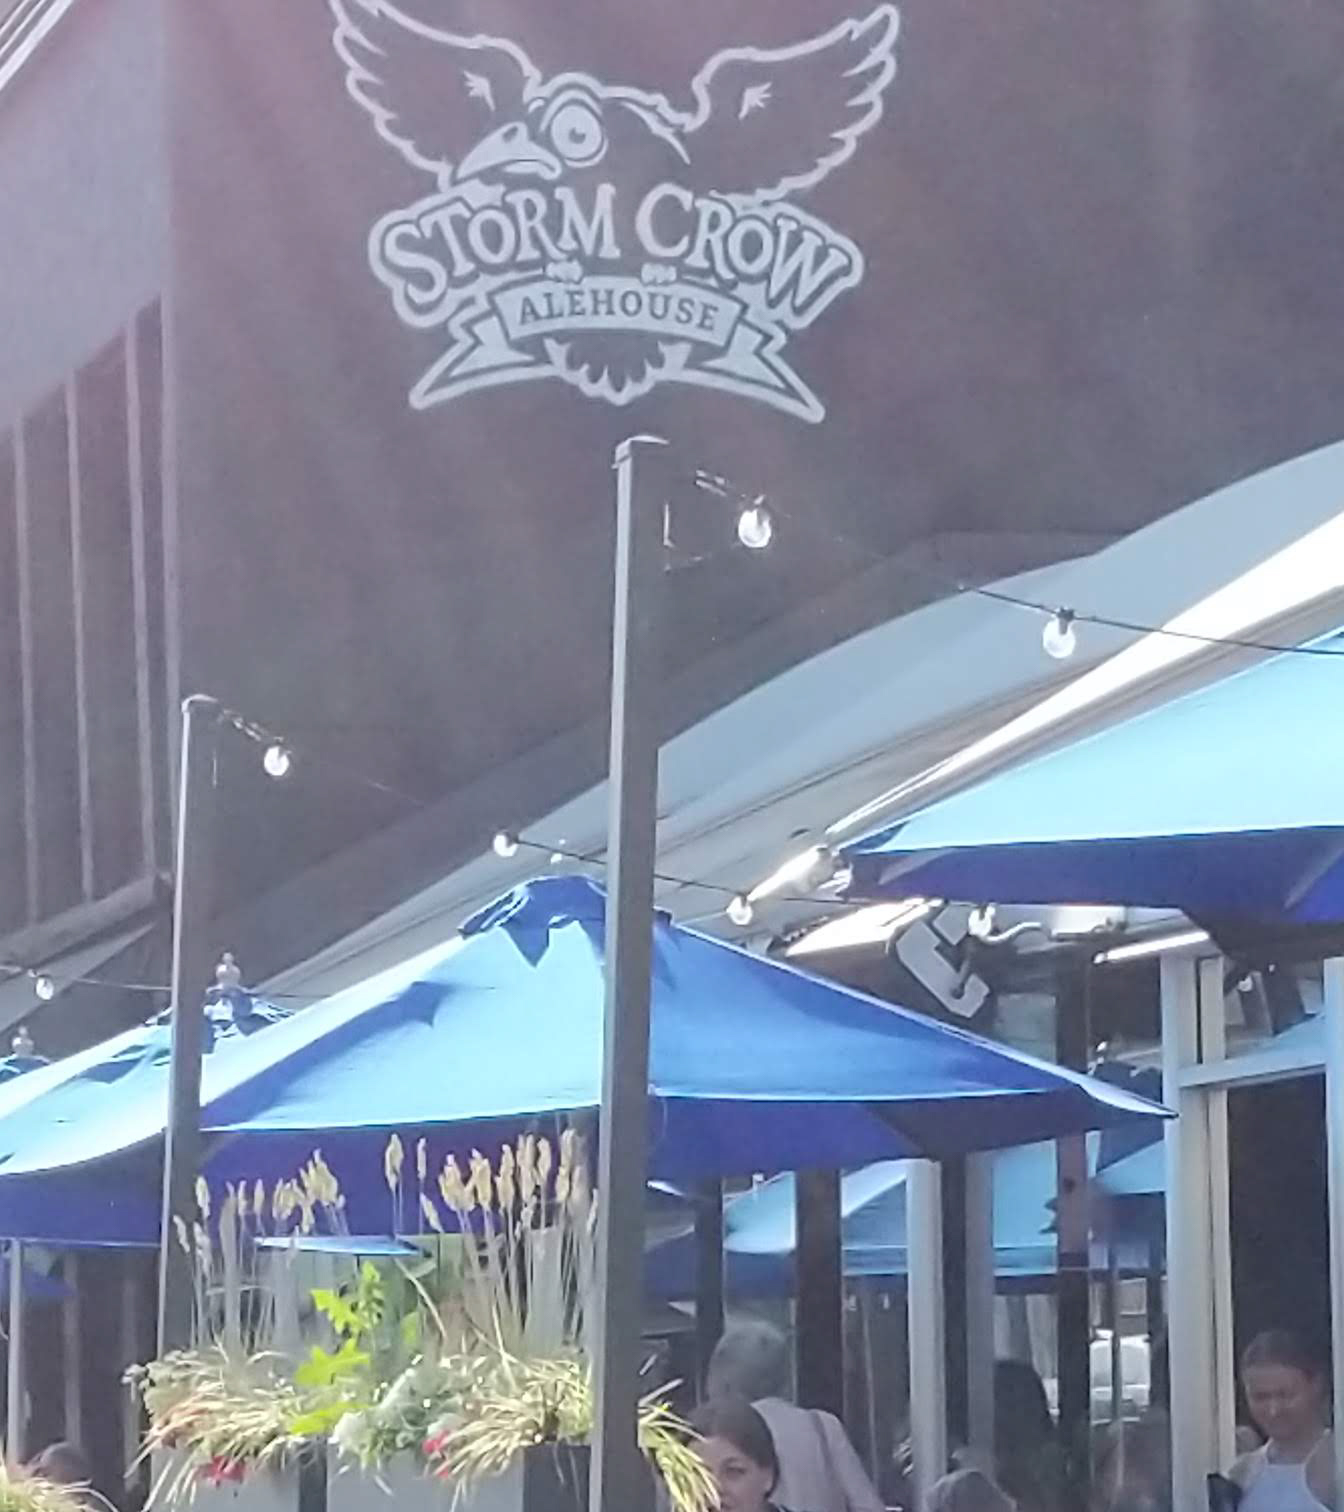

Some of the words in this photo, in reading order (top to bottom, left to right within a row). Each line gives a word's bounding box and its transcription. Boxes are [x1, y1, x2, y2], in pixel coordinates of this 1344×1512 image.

[384, 183, 622, 304] STORM
[635, 182, 850, 316] CROW
[518, 289, 719, 331] ALEHOUSE
